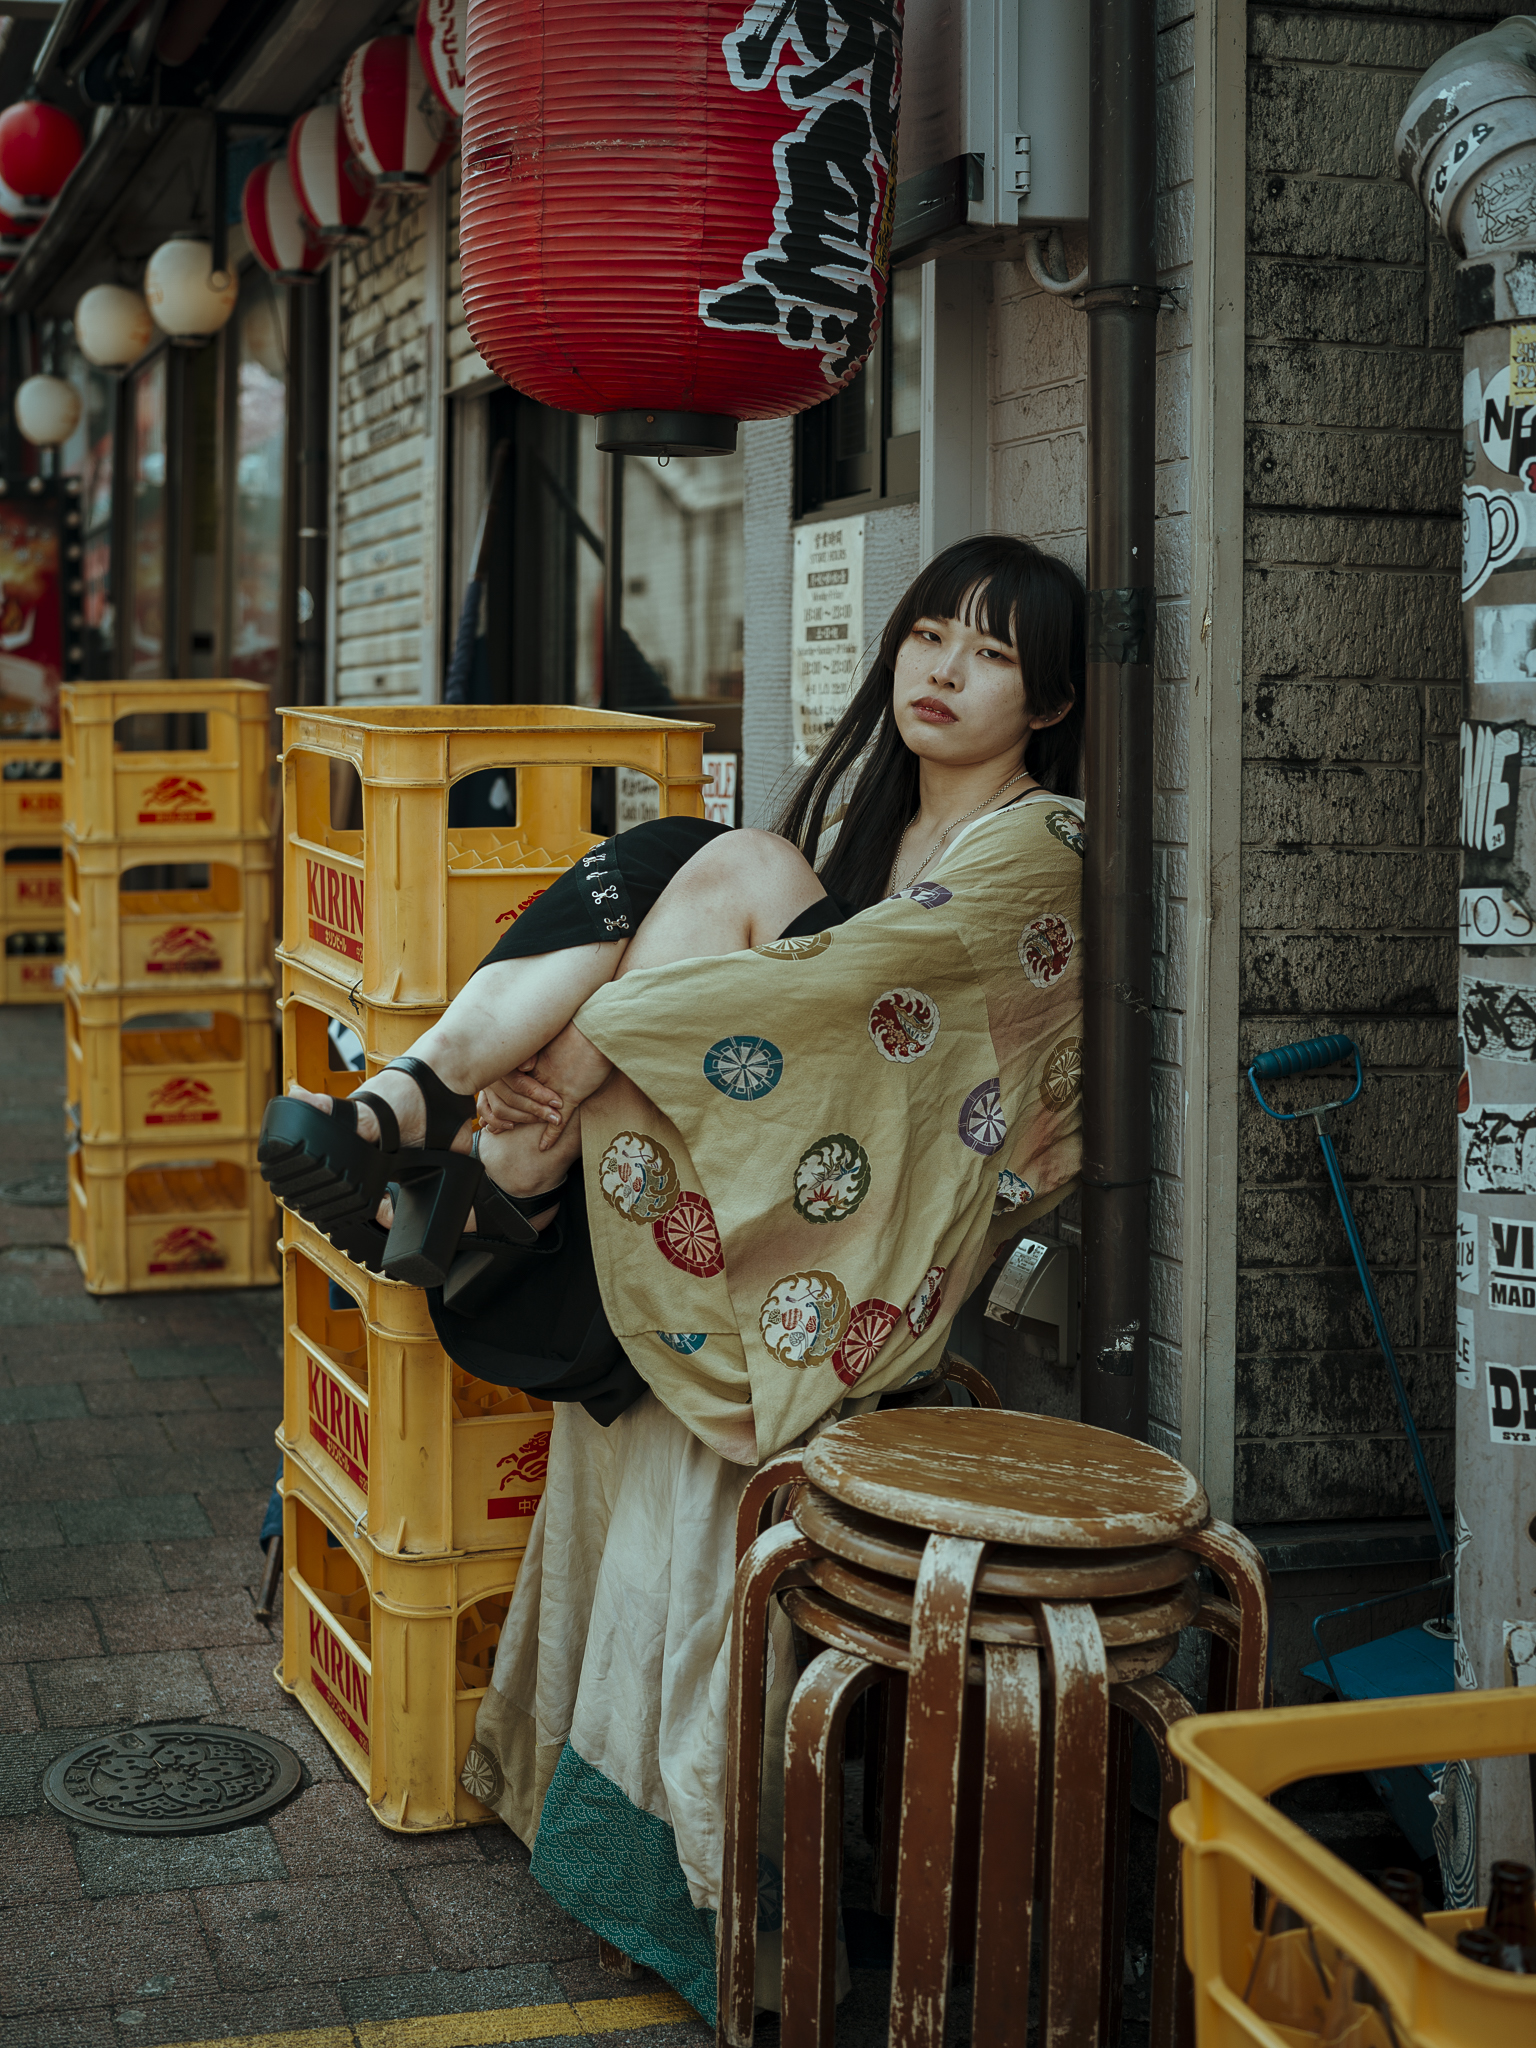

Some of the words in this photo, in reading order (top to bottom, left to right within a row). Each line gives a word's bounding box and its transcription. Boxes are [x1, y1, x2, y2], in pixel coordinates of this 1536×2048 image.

[306, 858, 364, 937] KIRIN
[324, 928, 347, 953] キリンビール
[307, 1356, 368, 1471] KIRIN
[326, 1437, 350, 1473] キリンビール
[309, 1607, 369, 1726] KIRIN
